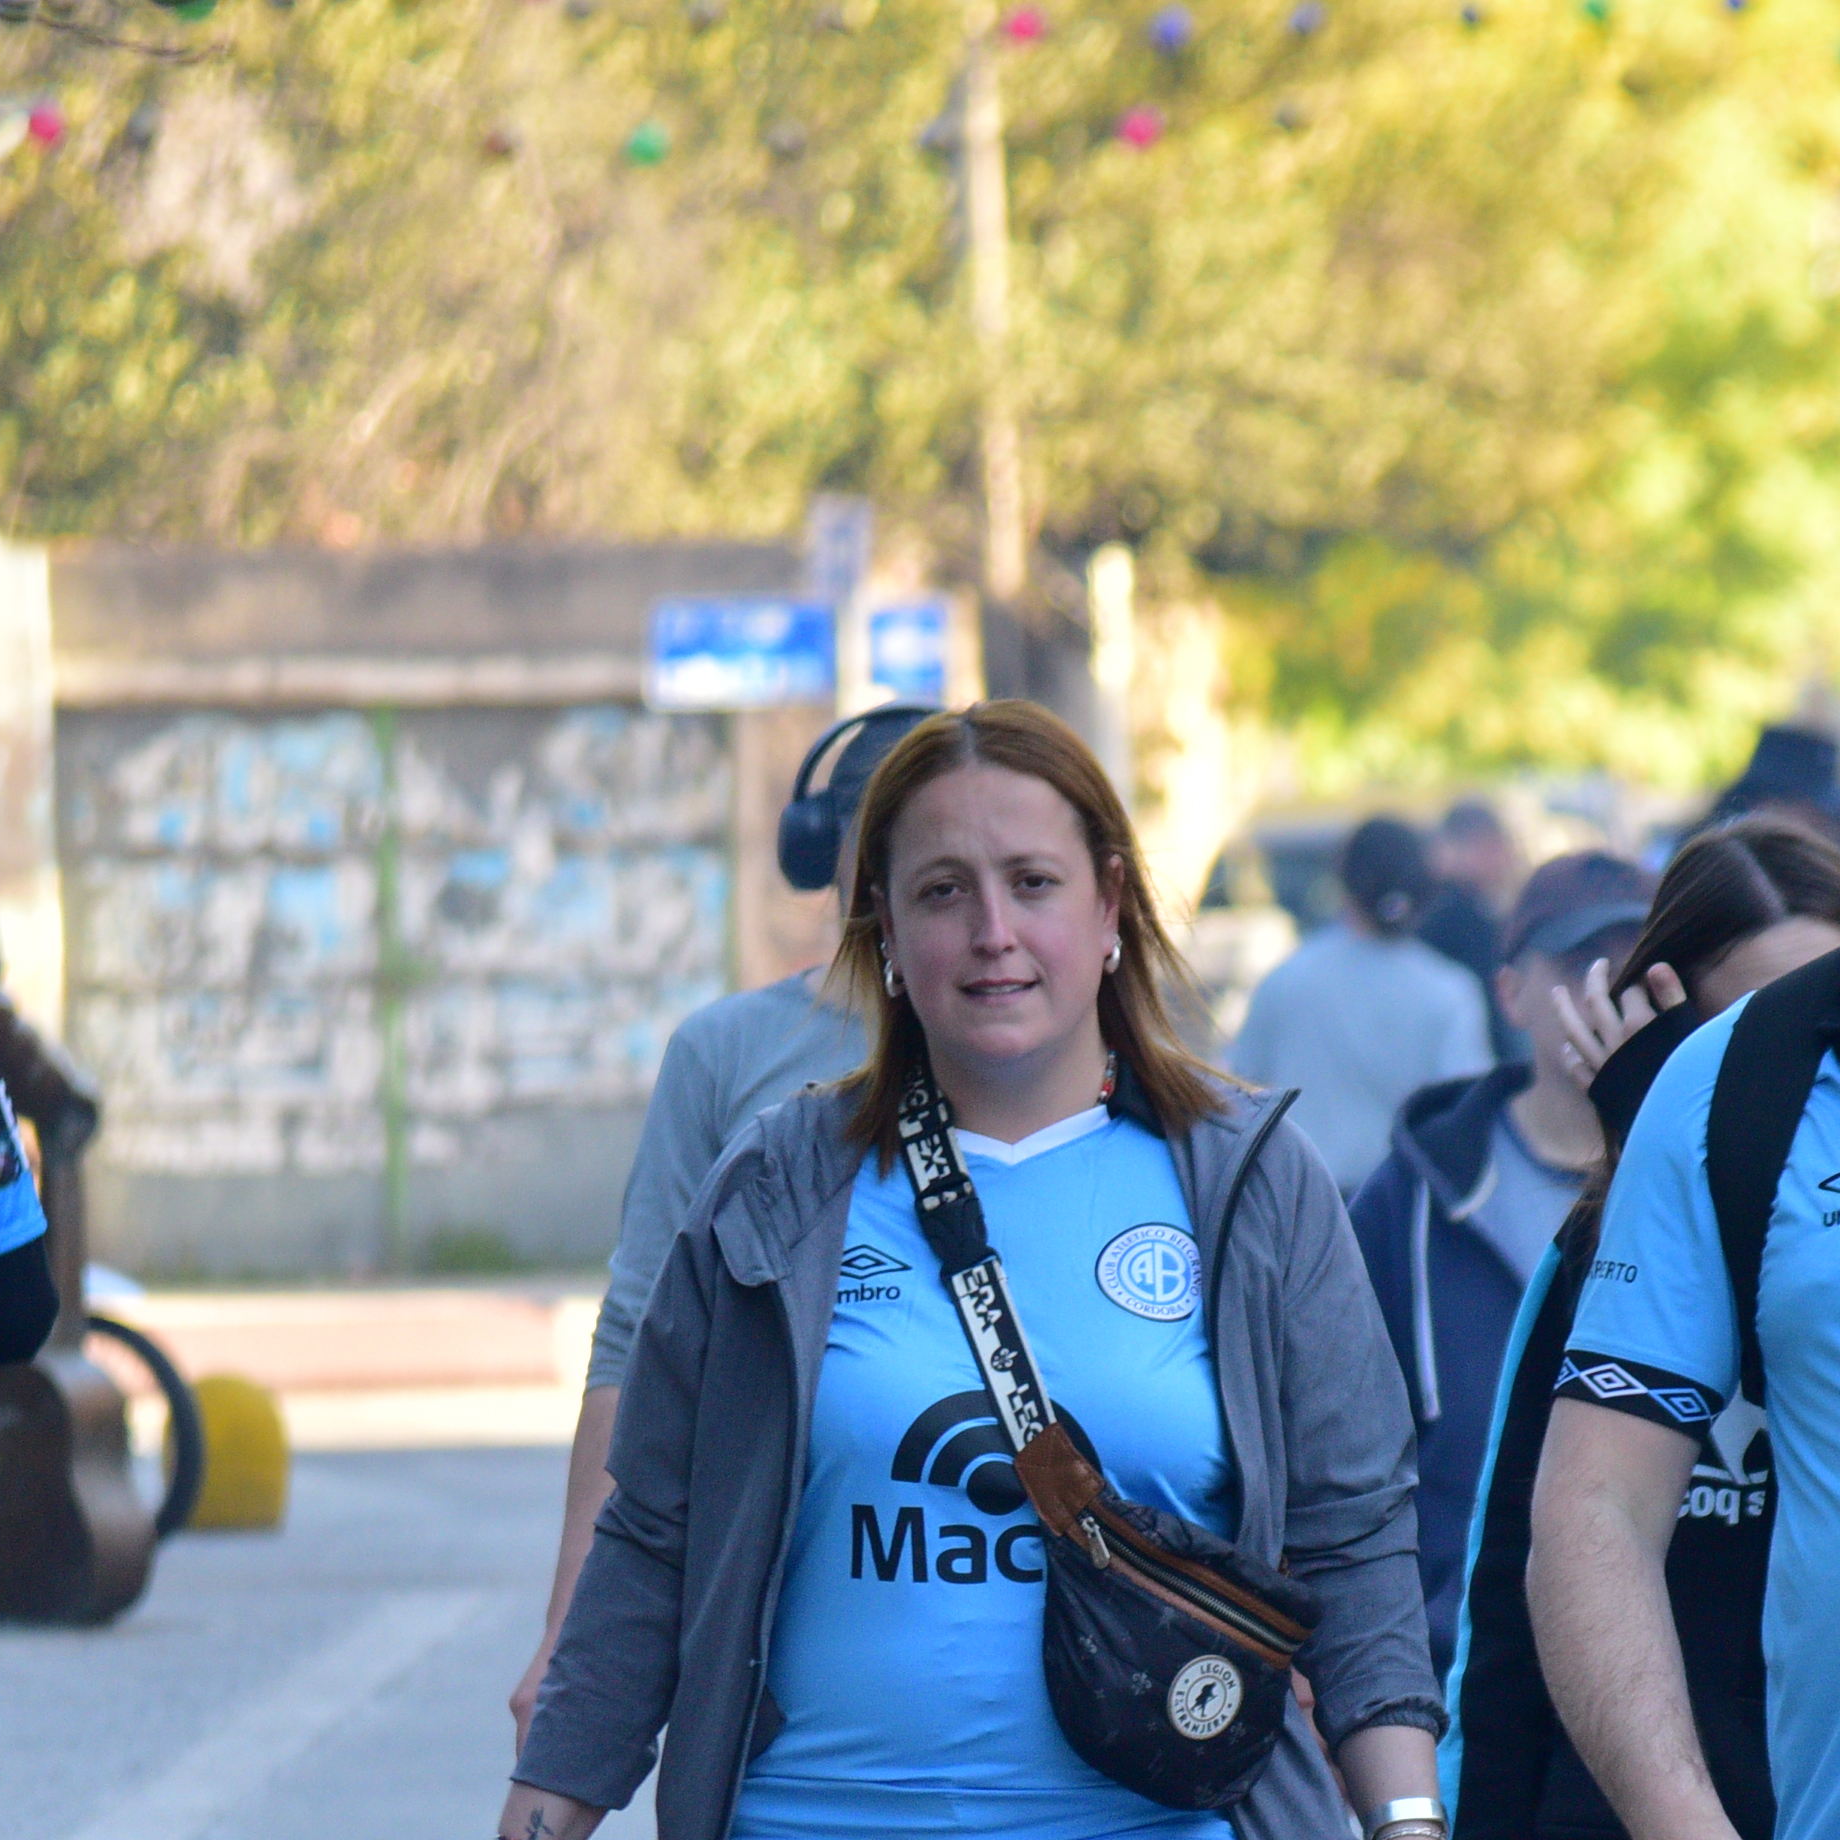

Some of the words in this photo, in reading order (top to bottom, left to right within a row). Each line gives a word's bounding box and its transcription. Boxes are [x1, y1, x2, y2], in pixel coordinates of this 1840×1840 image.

[1111, 1229, 1166, 1259] ATLETICO
[1105, 1261, 1120, 1289] CLUB
[837, 1283, 901, 1304] mbro
[1125, 1297, 1185, 1316] CORDOBA
[850, 1503, 1045, 1585] Mac
[1200, 1662, 1237, 1690] LEGION
[1174, 1690, 1229, 1734] EXTRANJERA
